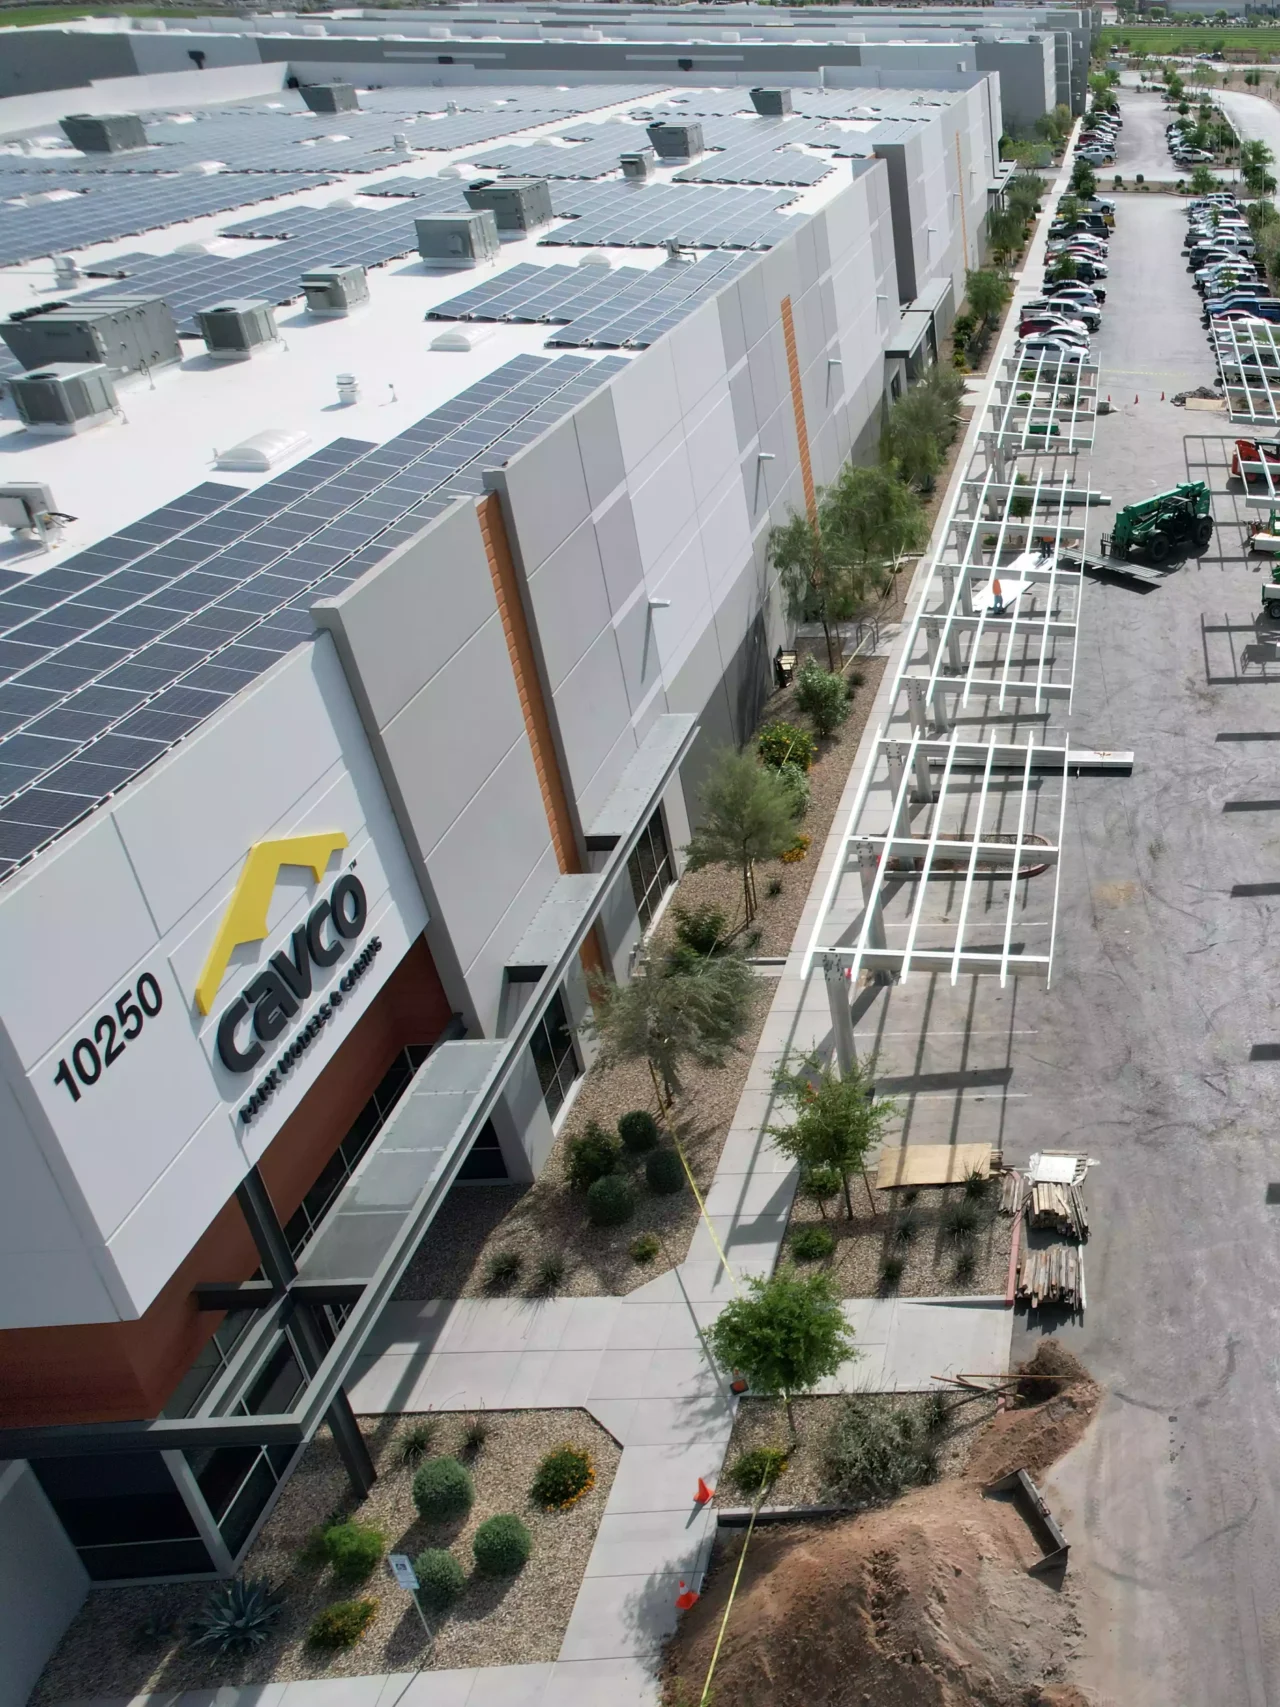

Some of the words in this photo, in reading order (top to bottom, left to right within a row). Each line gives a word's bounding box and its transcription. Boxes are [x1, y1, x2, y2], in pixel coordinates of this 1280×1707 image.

[53, 972, 163, 1103] 10250
[239, 1068, 282, 1124] PARK
[277, 1002, 333, 1074] MODELS
[330, 990, 343, 1007] &
[340, 936, 382, 992] CABINS
